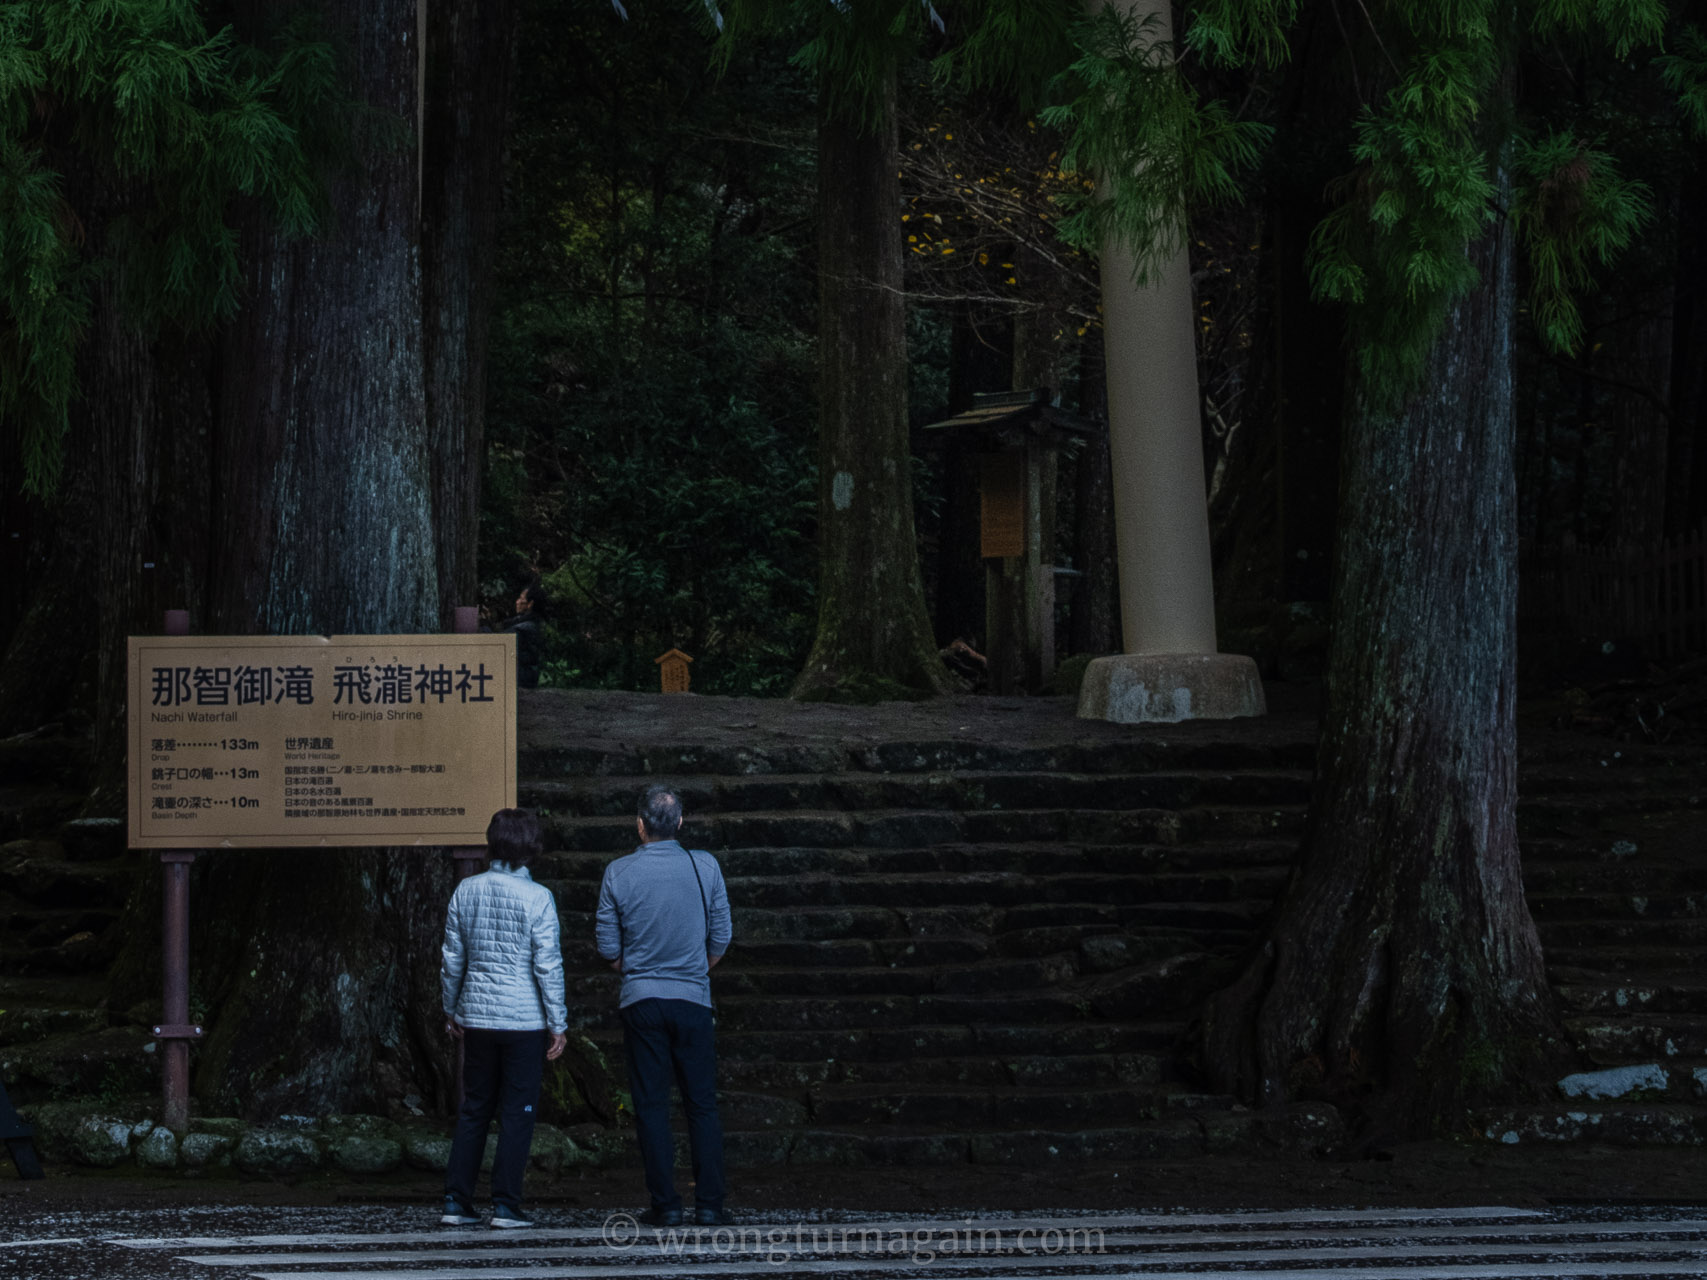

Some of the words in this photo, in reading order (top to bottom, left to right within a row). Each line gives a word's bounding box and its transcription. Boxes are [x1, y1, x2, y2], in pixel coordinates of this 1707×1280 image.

[151, 665, 314, 706] 那智御滝
[333, 664, 494, 704] 飛瀧神社
[151, 712, 184, 722] Nachi
[188, 712, 238, 722] Waterfall
[332, 710, 383, 721] Hiro-jinja
[387, 710, 423, 720] Shrine
[285, 737, 334, 750] 世界遺産
[308, 753, 340, 761] Heritage
[175, 812, 197, 820] Depth
